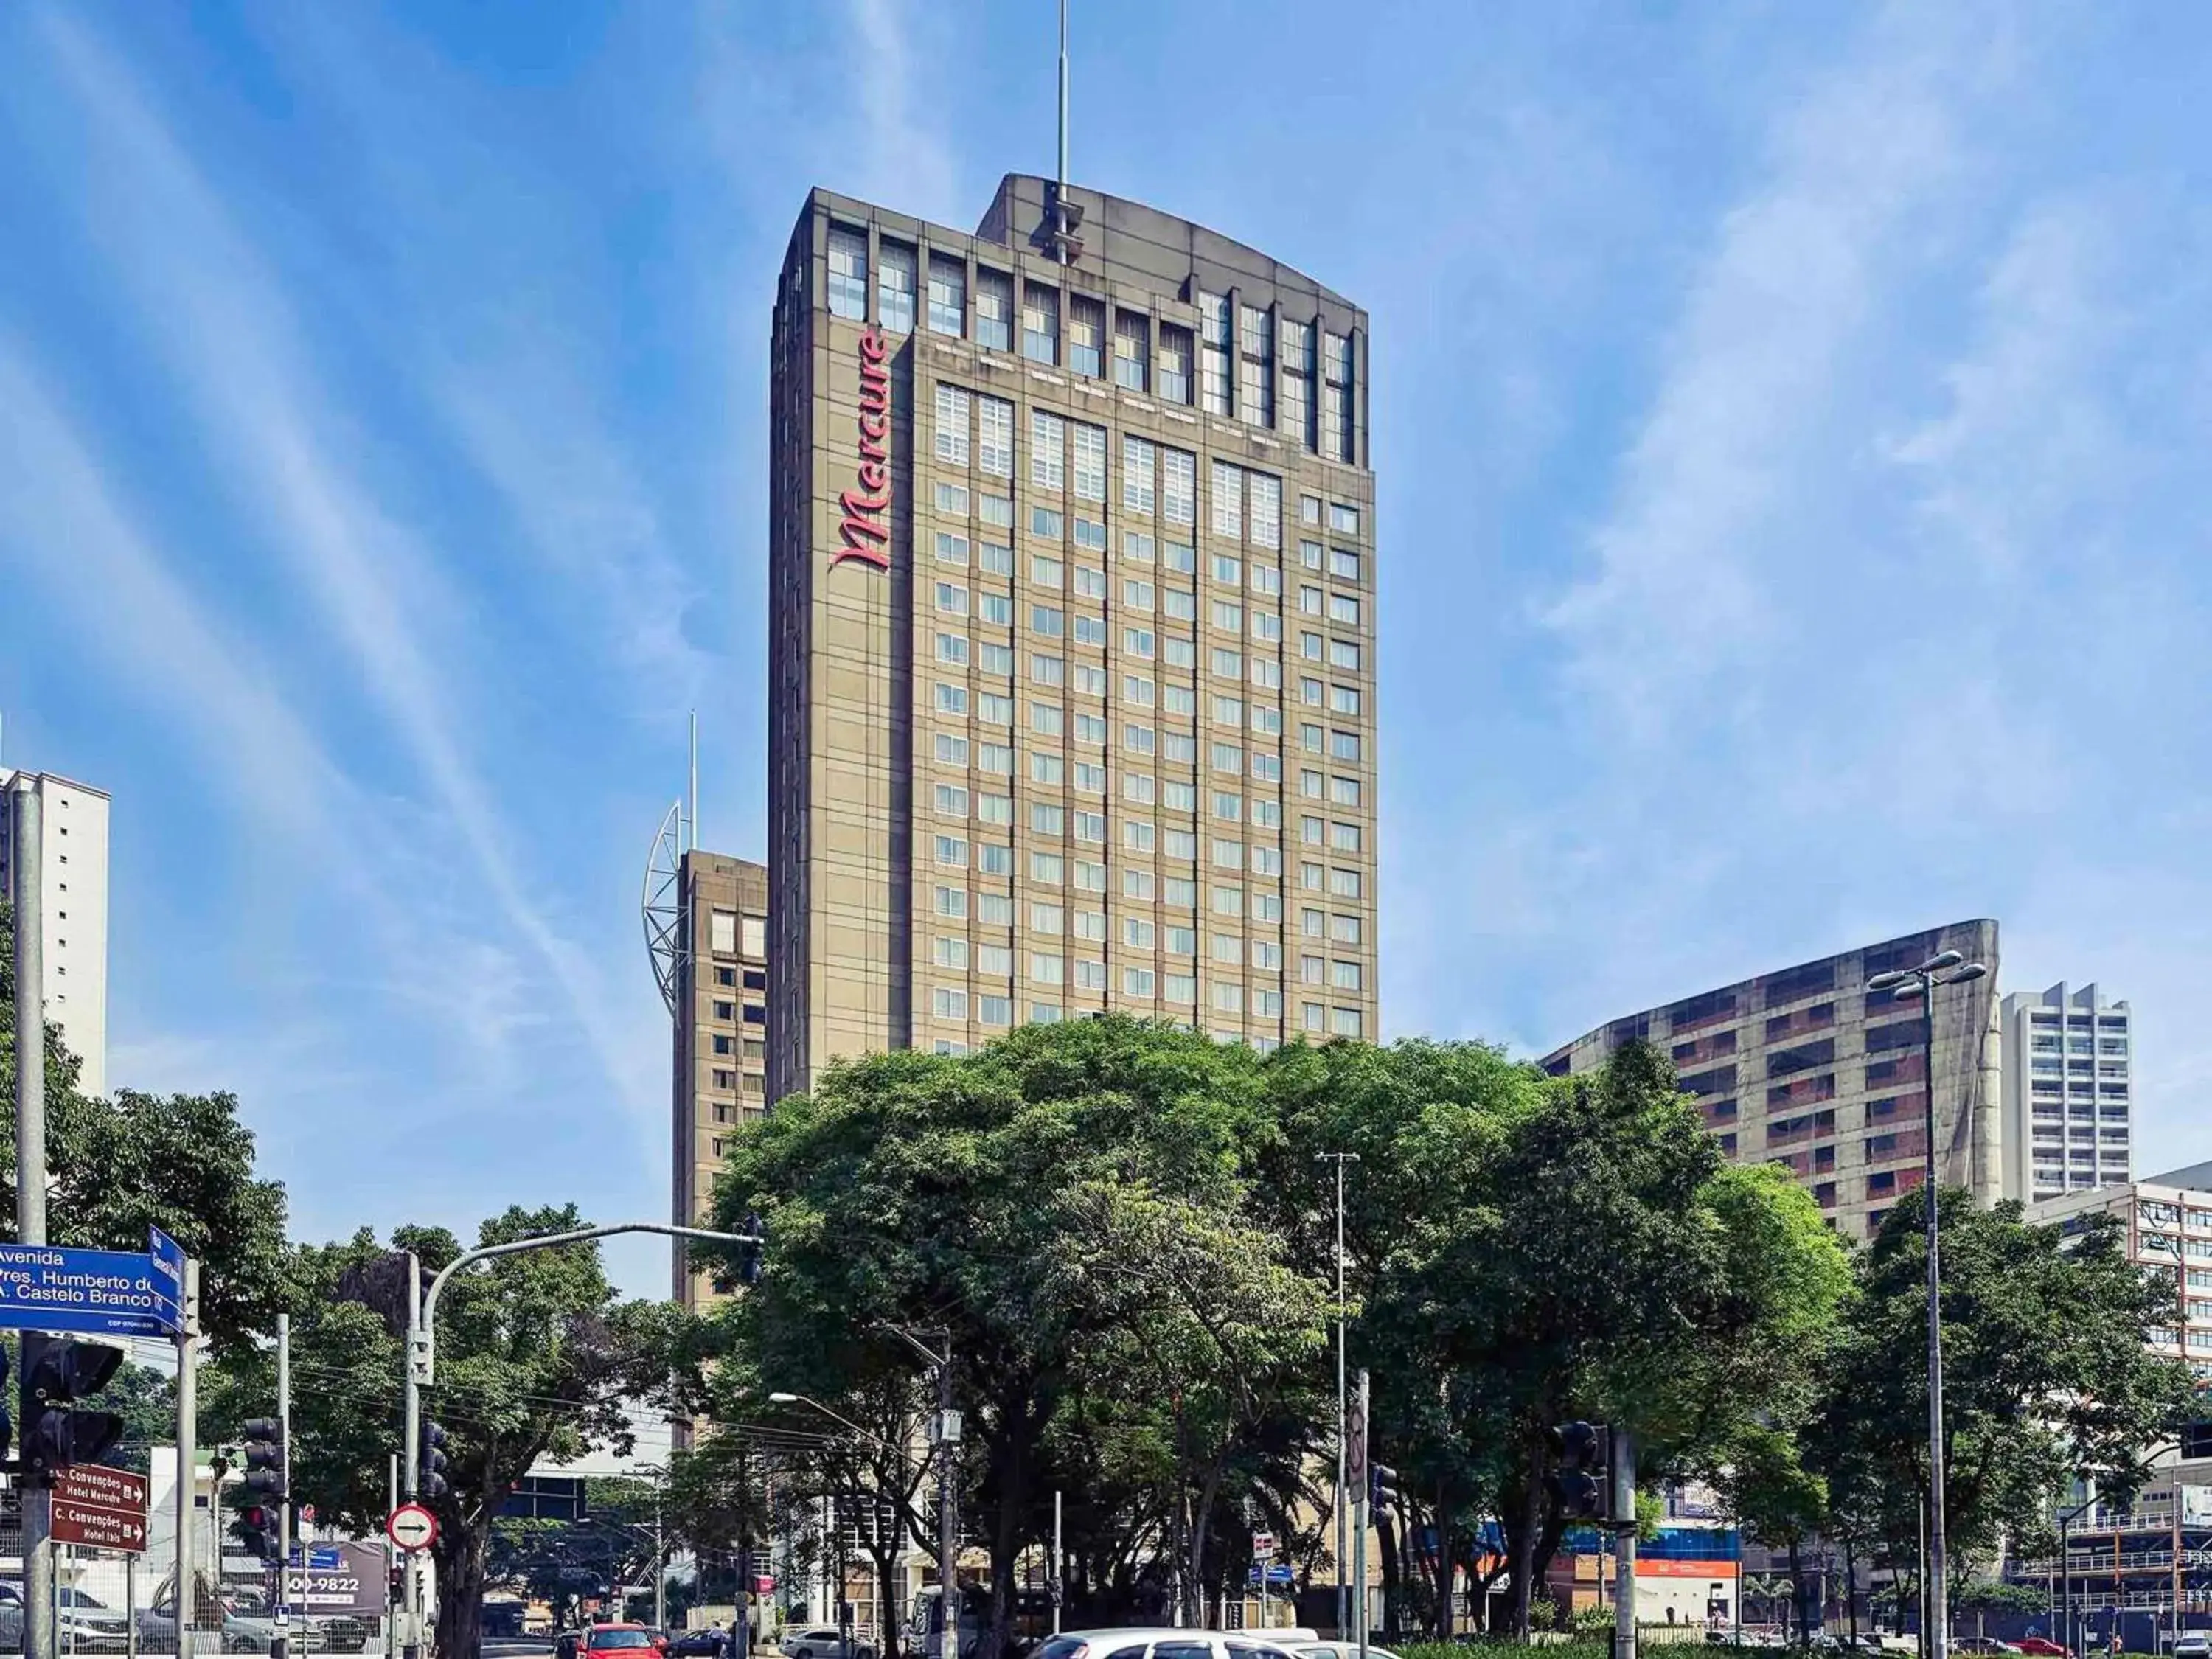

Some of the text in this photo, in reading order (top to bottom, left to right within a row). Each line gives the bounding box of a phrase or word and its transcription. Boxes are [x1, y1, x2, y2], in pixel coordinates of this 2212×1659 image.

[827, 330, 891, 573] Mercure
[42, 1270, 131, 1290] Humberto
[16, 1284, 83, 1303] Castelo
[89, 1289, 151, 1307] Branco
[69, 1468, 122, 1489] Convenções
[66, 1484, 120, 1503] Hotel Mercure
[55, 1507, 121, 1528] C. Convenções
[83, 1528, 105, 1540] Hotel
[288, 1577, 359, 1591] 00-9822
